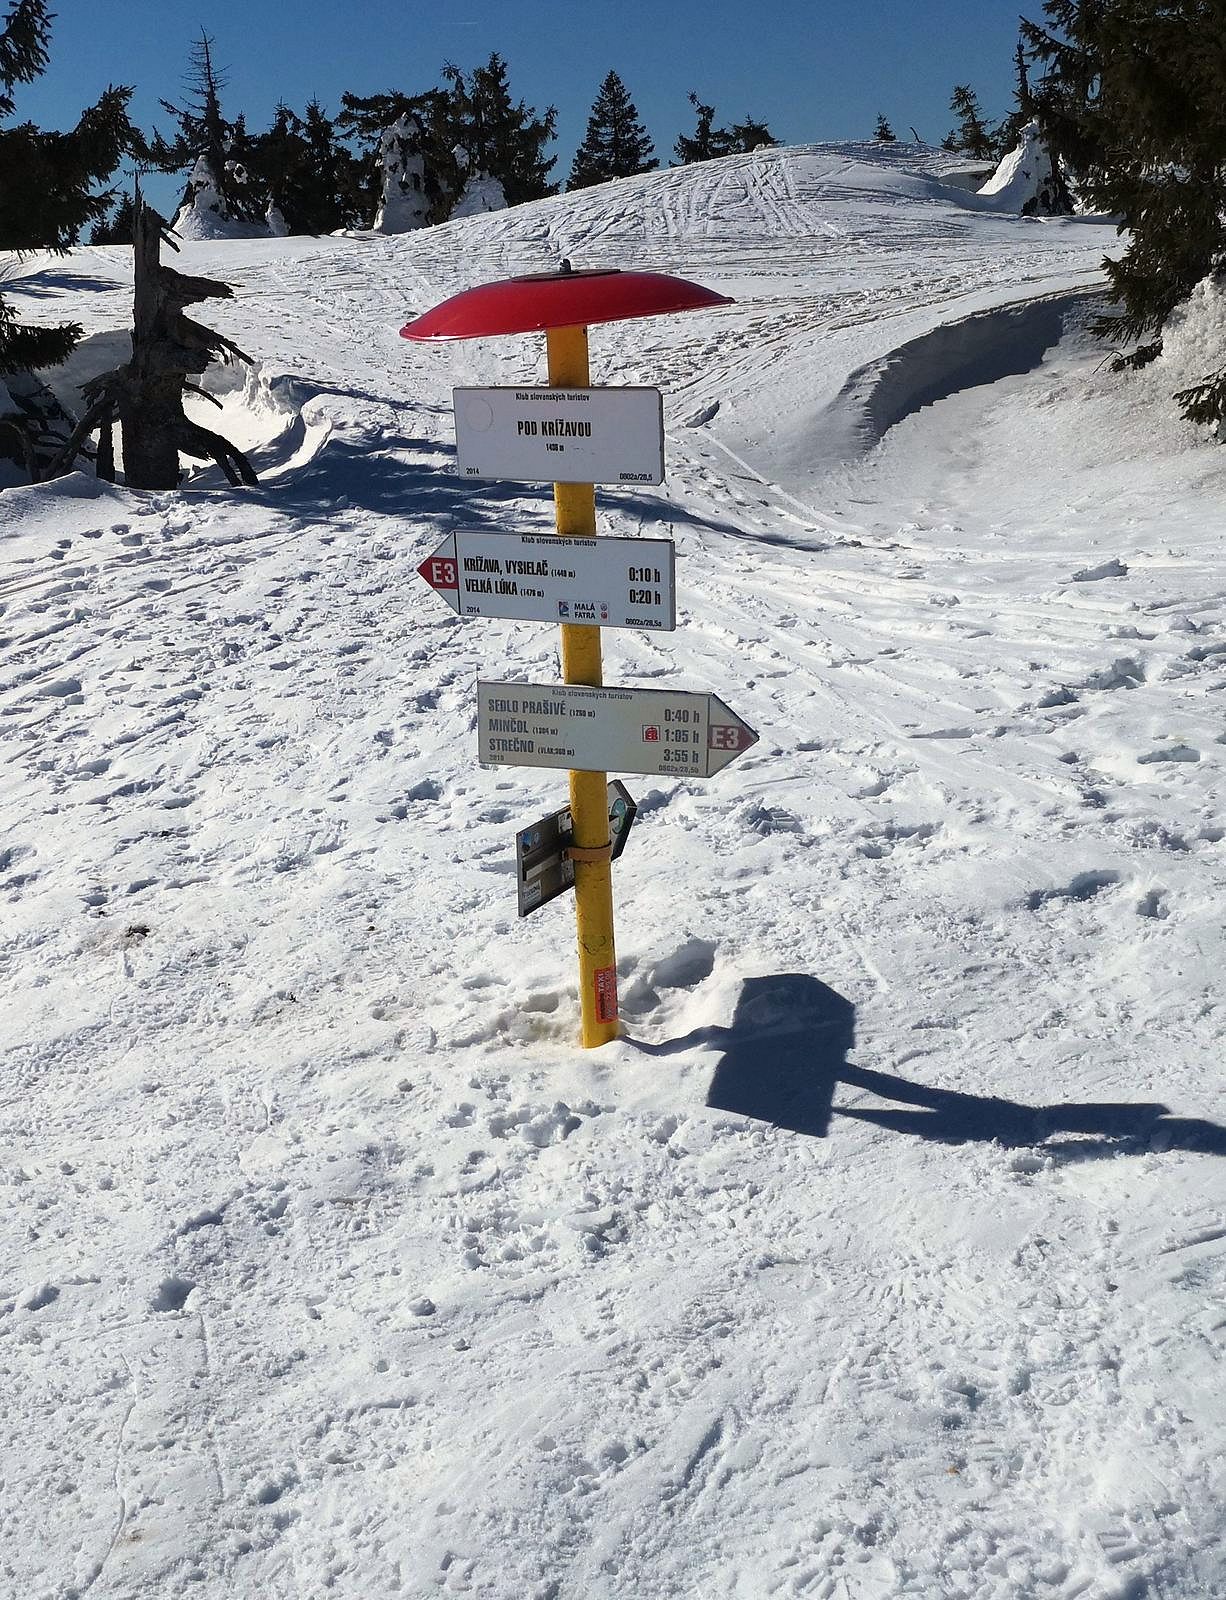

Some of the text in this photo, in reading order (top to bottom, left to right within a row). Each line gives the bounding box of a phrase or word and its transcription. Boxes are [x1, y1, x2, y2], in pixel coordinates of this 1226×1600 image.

[515, 392, 590, 403] Klub slovenských turistov
[517, 418, 592, 437] POD KRÍŽAVOU
[466, 467, 480, 475] 2014
[521, 536, 598, 547] Klub slovenských turistov
[432, 562, 456, 584] E3
[463, 556, 503, 576] KRÍŽAVA,
[505, 560, 549, 577] VYSIELAČ
[628, 567, 661, 583] 0:10 h
[494, 578, 518, 596] LÚKA
[629, 589, 661, 606] 0:20 h
[466, 606, 481, 614] 2014
[574, 603, 596, 611] MALÁ
[574, 611, 596, 620] FATRA
[568, 690, 607, 700] slovenských
[608, 692, 633, 700] turistov
[488, 698, 519, 713] SEDLO
[522, 699, 566, 716] PRAŠIVÉ
[664, 708, 700, 724] 0:40 h
[488, 717, 529, 733] MINČOL
[664, 728, 700, 744] 1:05 h
[711, 726, 739, 749] E3
[489, 737, 535, 754] STREČNO
[663, 748, 699, 764] 3:55 h
